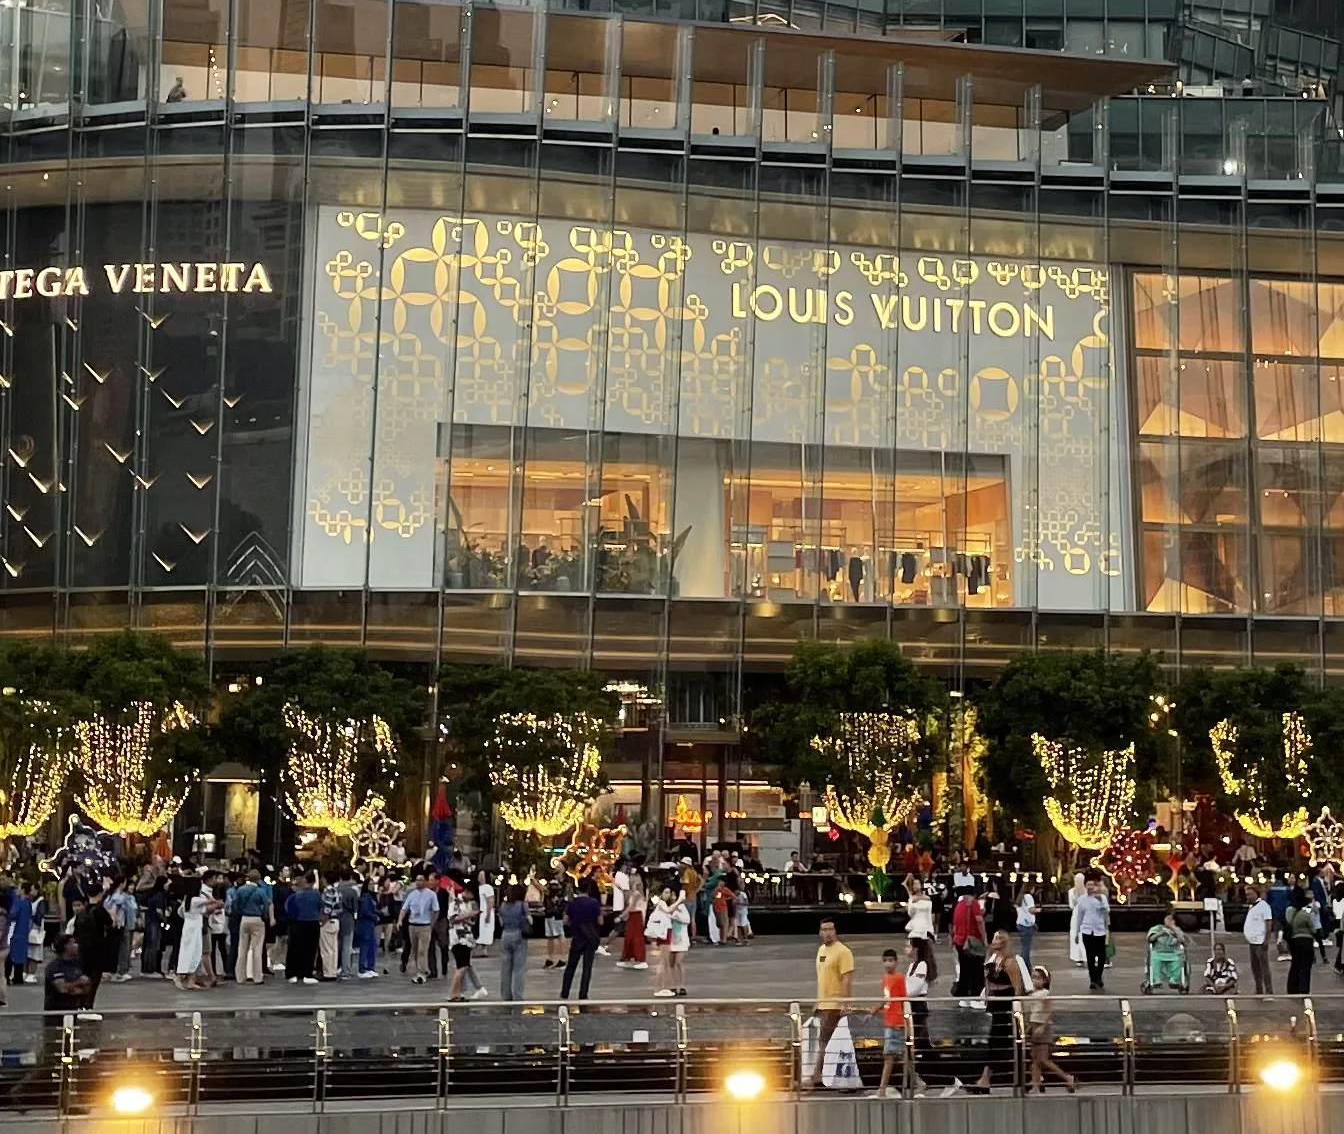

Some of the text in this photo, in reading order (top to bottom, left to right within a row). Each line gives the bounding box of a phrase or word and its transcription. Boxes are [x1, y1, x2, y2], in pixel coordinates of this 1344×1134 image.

[103, 263, 273, 294] VENETA
[732, 282, 1054, 341] LOUIS VUITTON
